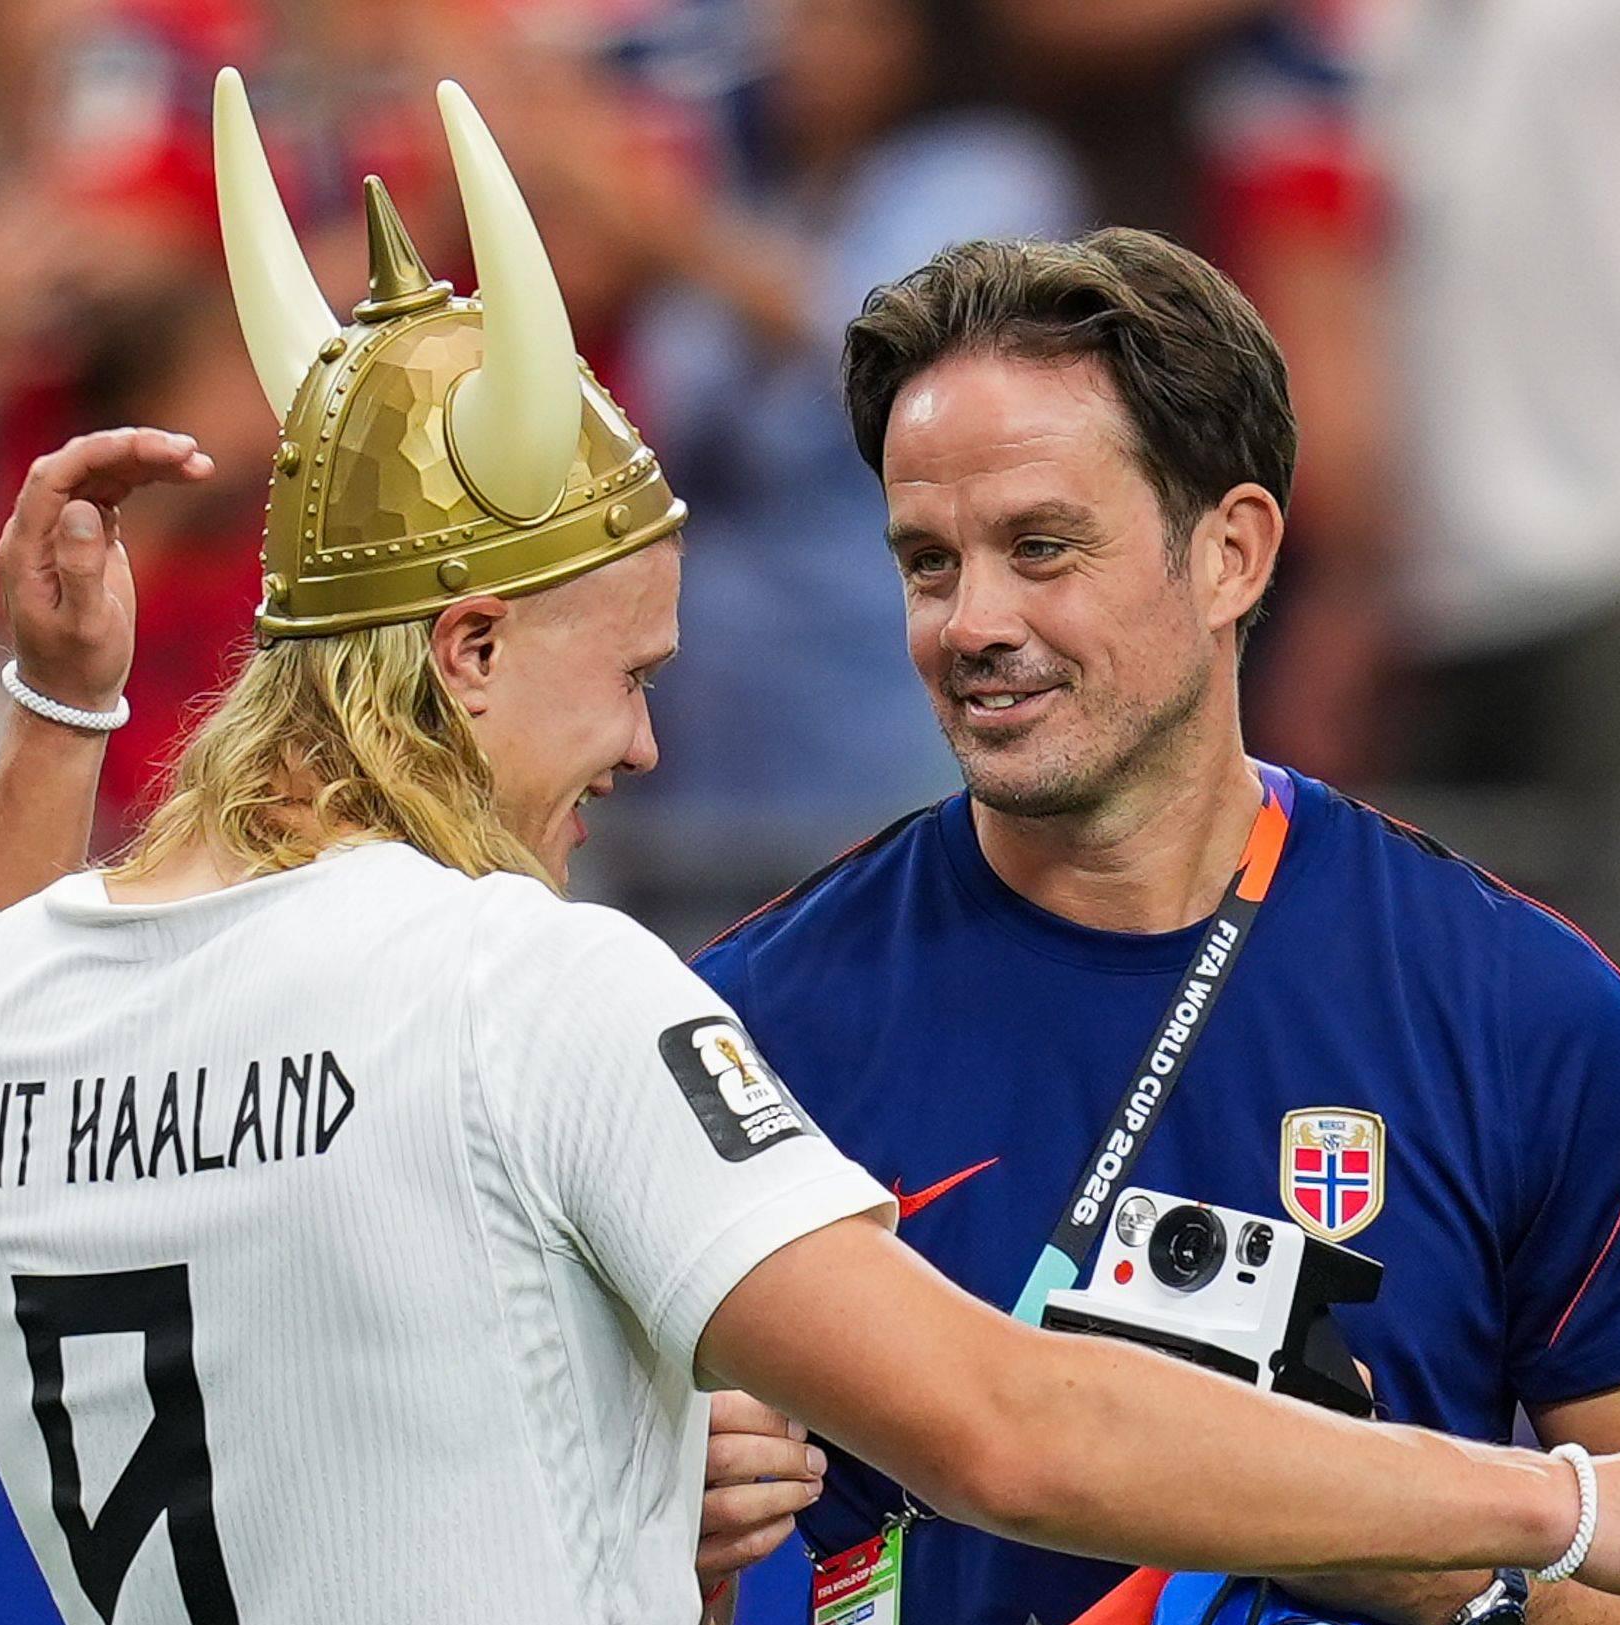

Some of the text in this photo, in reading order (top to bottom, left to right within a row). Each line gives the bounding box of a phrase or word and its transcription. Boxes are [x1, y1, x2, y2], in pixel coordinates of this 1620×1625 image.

[67, 1050, 355, 1183] HAALAND
[1071, 919, 1239, 1226] FIFA WORLD CUP 2026
